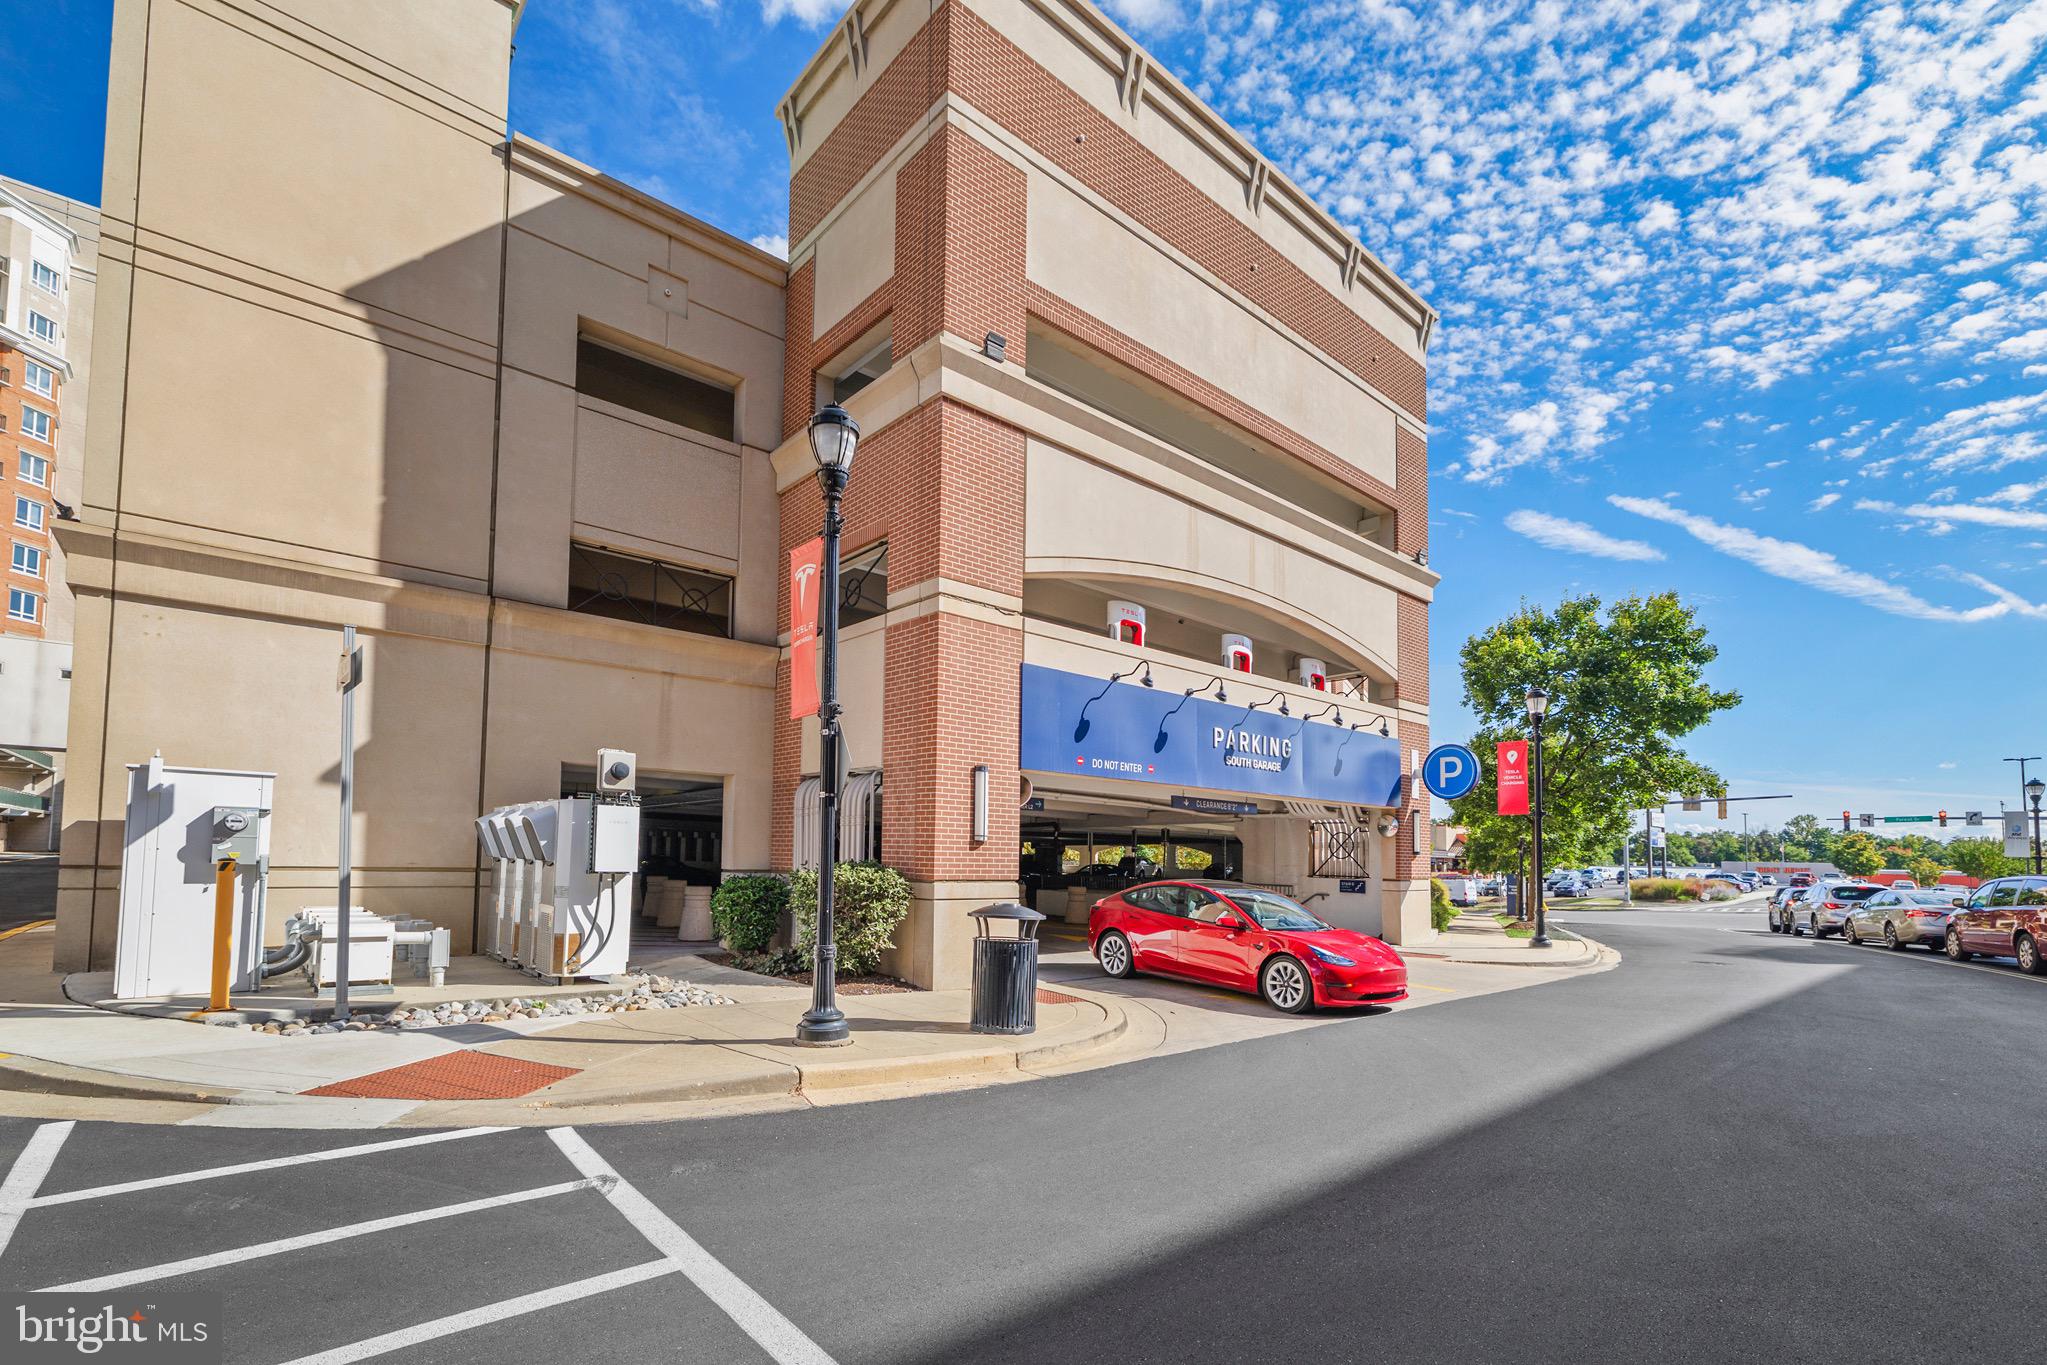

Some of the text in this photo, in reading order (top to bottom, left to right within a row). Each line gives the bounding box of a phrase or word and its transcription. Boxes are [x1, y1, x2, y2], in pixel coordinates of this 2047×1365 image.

[793, 621, 815, 638] TESLA
[1213, 727, 1292, 758] PARKING
[1092, 758, 1143, 773] DO NOT ENTER
[1225, 755, 1282, 772] SOUTH GARAGE
[1439, 756, 1463, 788] P
[1195, 800, 1227, 810] CLEARANCE
